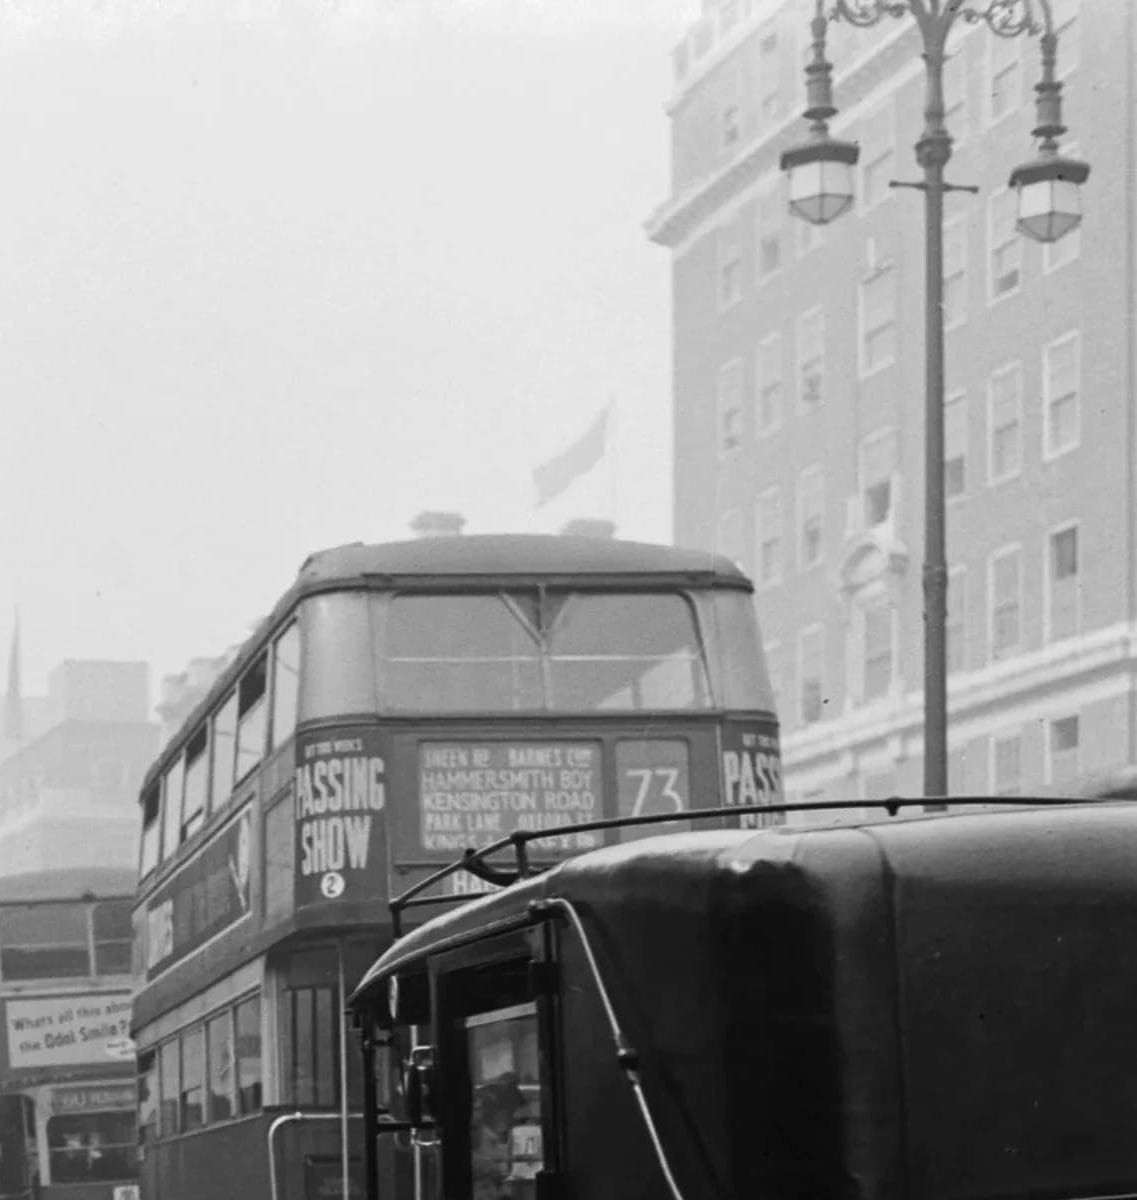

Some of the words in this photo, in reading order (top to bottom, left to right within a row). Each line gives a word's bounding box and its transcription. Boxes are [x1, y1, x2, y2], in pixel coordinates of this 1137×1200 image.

[508, 747, 562, 769] BARNES
[296, 756, 385, 820] PASSING
[421, 769, 555, 791] HAMMERSMITH
[422, 791, 538, 811] KENSINGTON
[544, 790, 596, 811] ROAD
[625, 767, 684, 824] 73
[425, 812, 463, 832] PARK
[466, 812, 502, 831] LANE
[302, 815, 372, 874] SHOW
[58, 1006, 75, 1024] all
[76, 1005, 102, 1019] this
[19, 1039, 43, 1053] the
